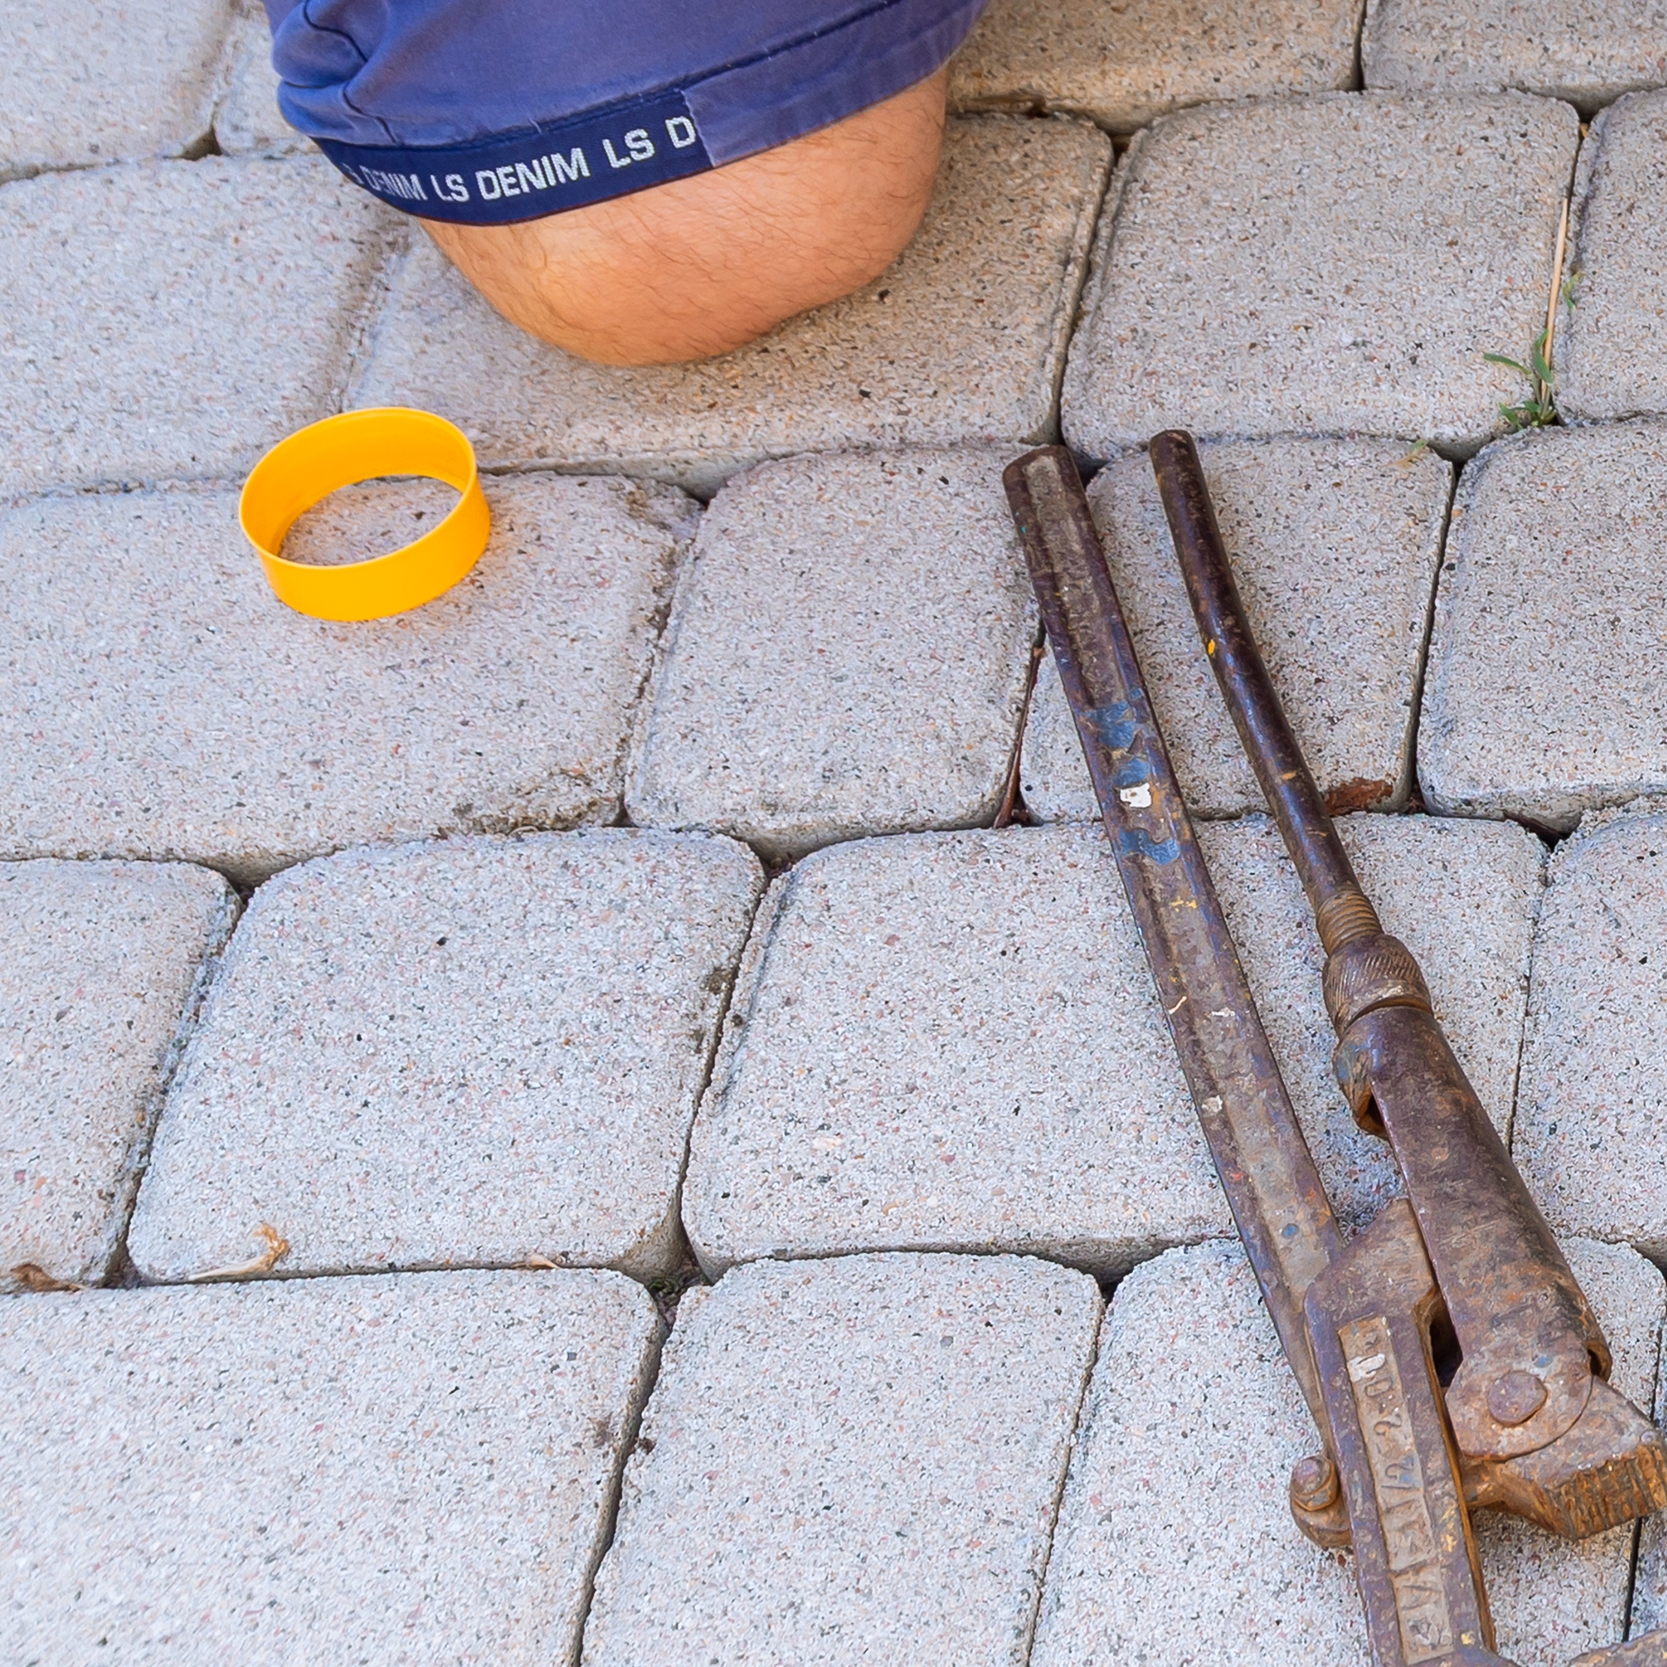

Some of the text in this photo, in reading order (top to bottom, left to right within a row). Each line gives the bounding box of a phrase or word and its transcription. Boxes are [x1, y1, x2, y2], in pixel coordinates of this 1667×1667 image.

[359, 164, 428, 202] DENIM
[430, 174, 470, 203] LS
[475, 147, 591, 202] DENIM
[602, 128, 656, 170] LS
